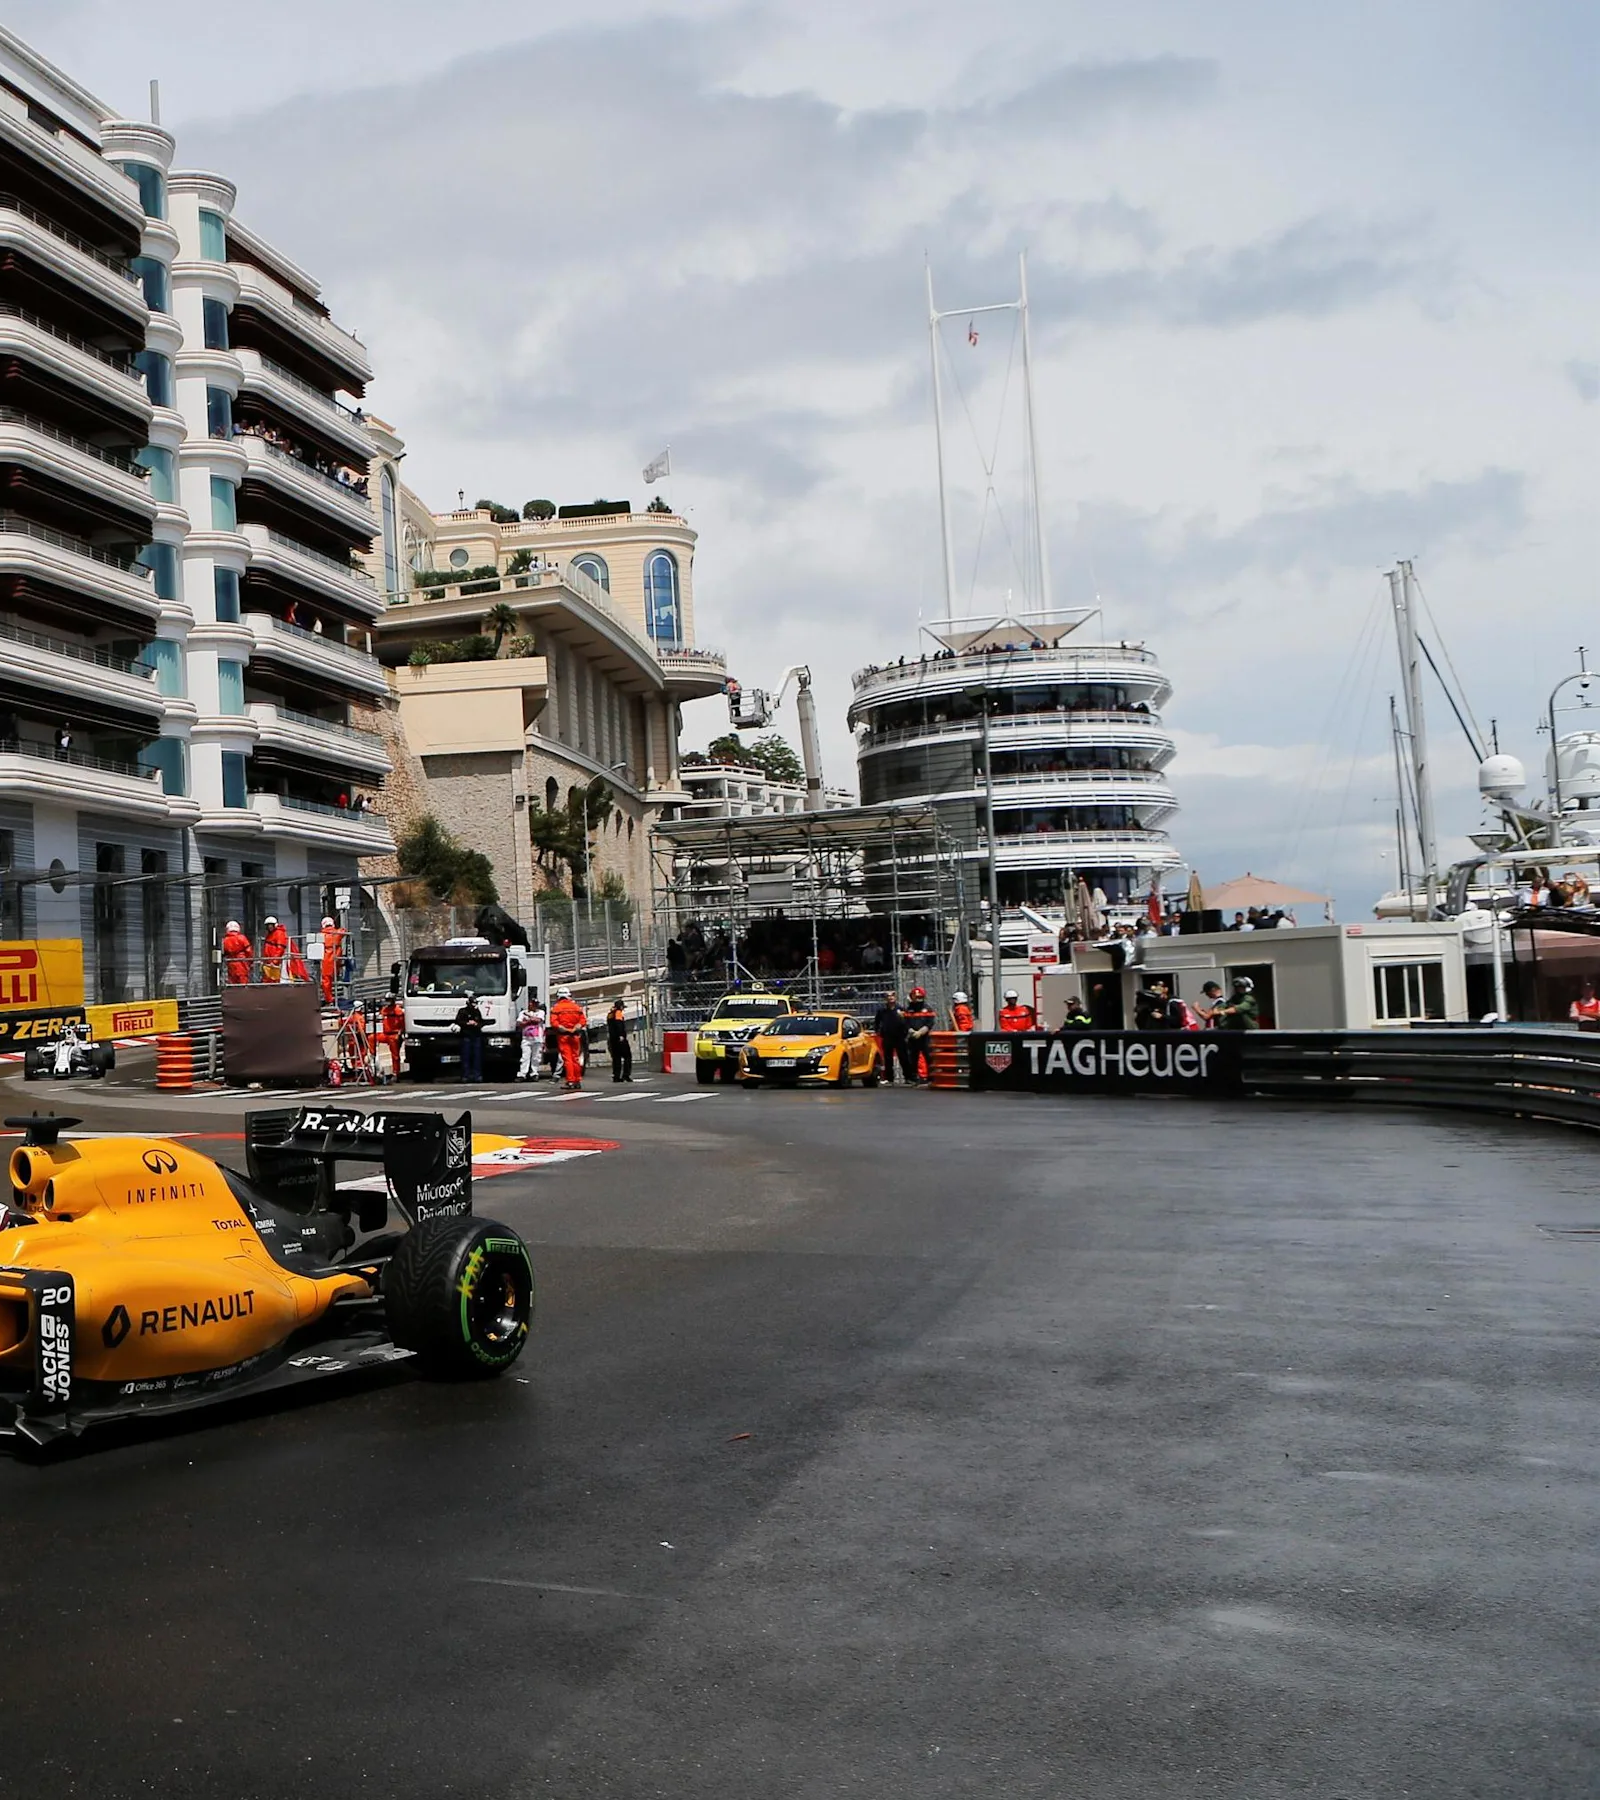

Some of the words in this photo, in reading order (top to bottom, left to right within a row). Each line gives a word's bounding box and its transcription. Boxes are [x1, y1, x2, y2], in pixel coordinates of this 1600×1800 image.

[112, 1009, 154, 1032] PIRELLI
[987, 1043, 1009, 1053] TAG
[127, 1183, 205, 1204] INFINITI
[417, 1177, 464, 1202] Microsoft
[485, 1238, 520, 1254] PIRELLI
[41, 1286, 71, 1306] 20
[140, 1290, 255, 1336] RENAULT
[42, 1339, 56, 1402] JACK
[56, 1323, 71, 1401] JONES
